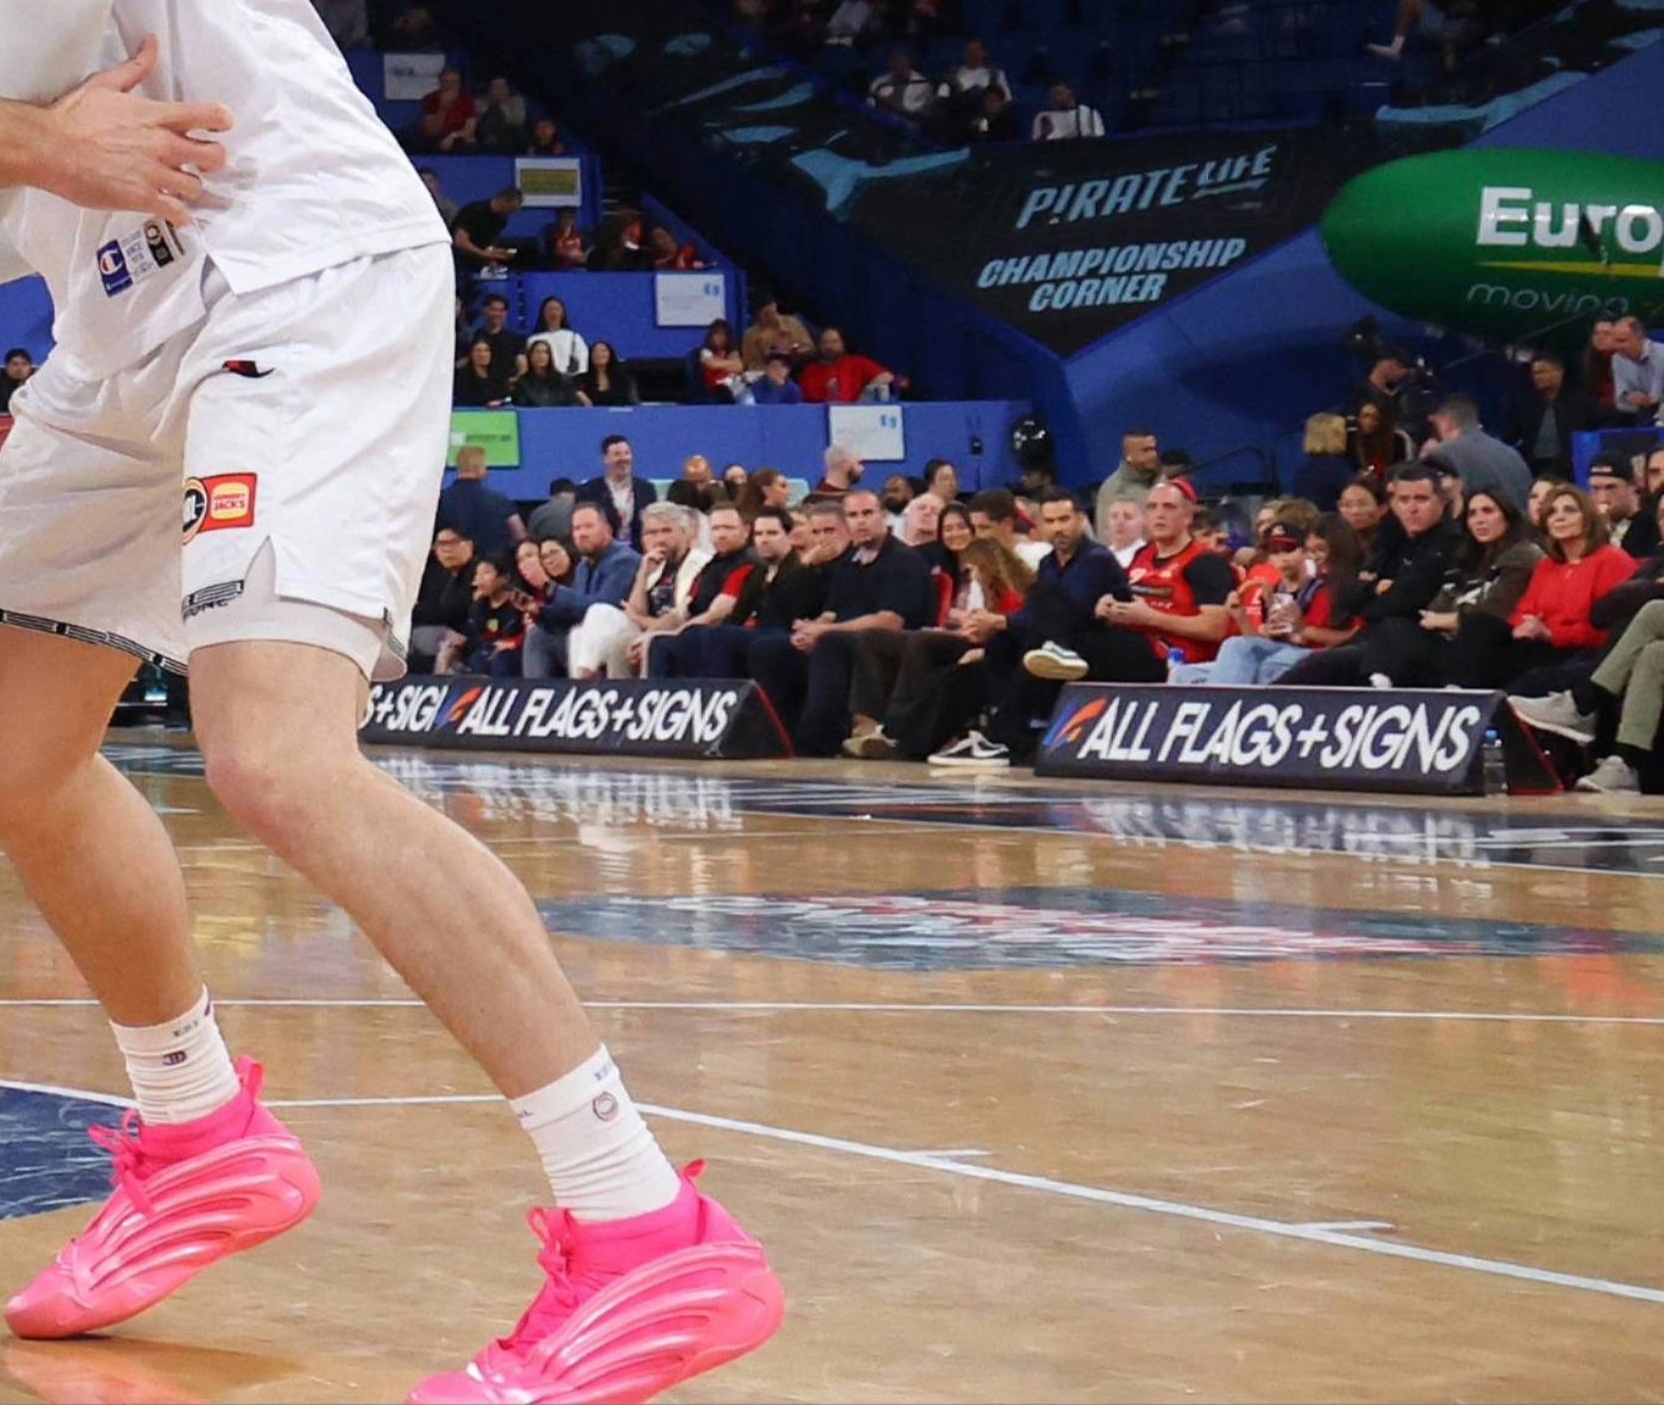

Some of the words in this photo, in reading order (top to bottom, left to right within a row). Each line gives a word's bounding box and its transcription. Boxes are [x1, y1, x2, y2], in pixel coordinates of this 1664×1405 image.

[1197, 145, 1277, 186] LIFE
[1475, 185, 1664, 255] Euro
[976, 238, 1246, 289] CHAMPIONSHIP
[1028, 273, 1168, 313] CORNER
[463, 686, 514, 736] ALL
[1077, 696, 1157, 760] ALL
